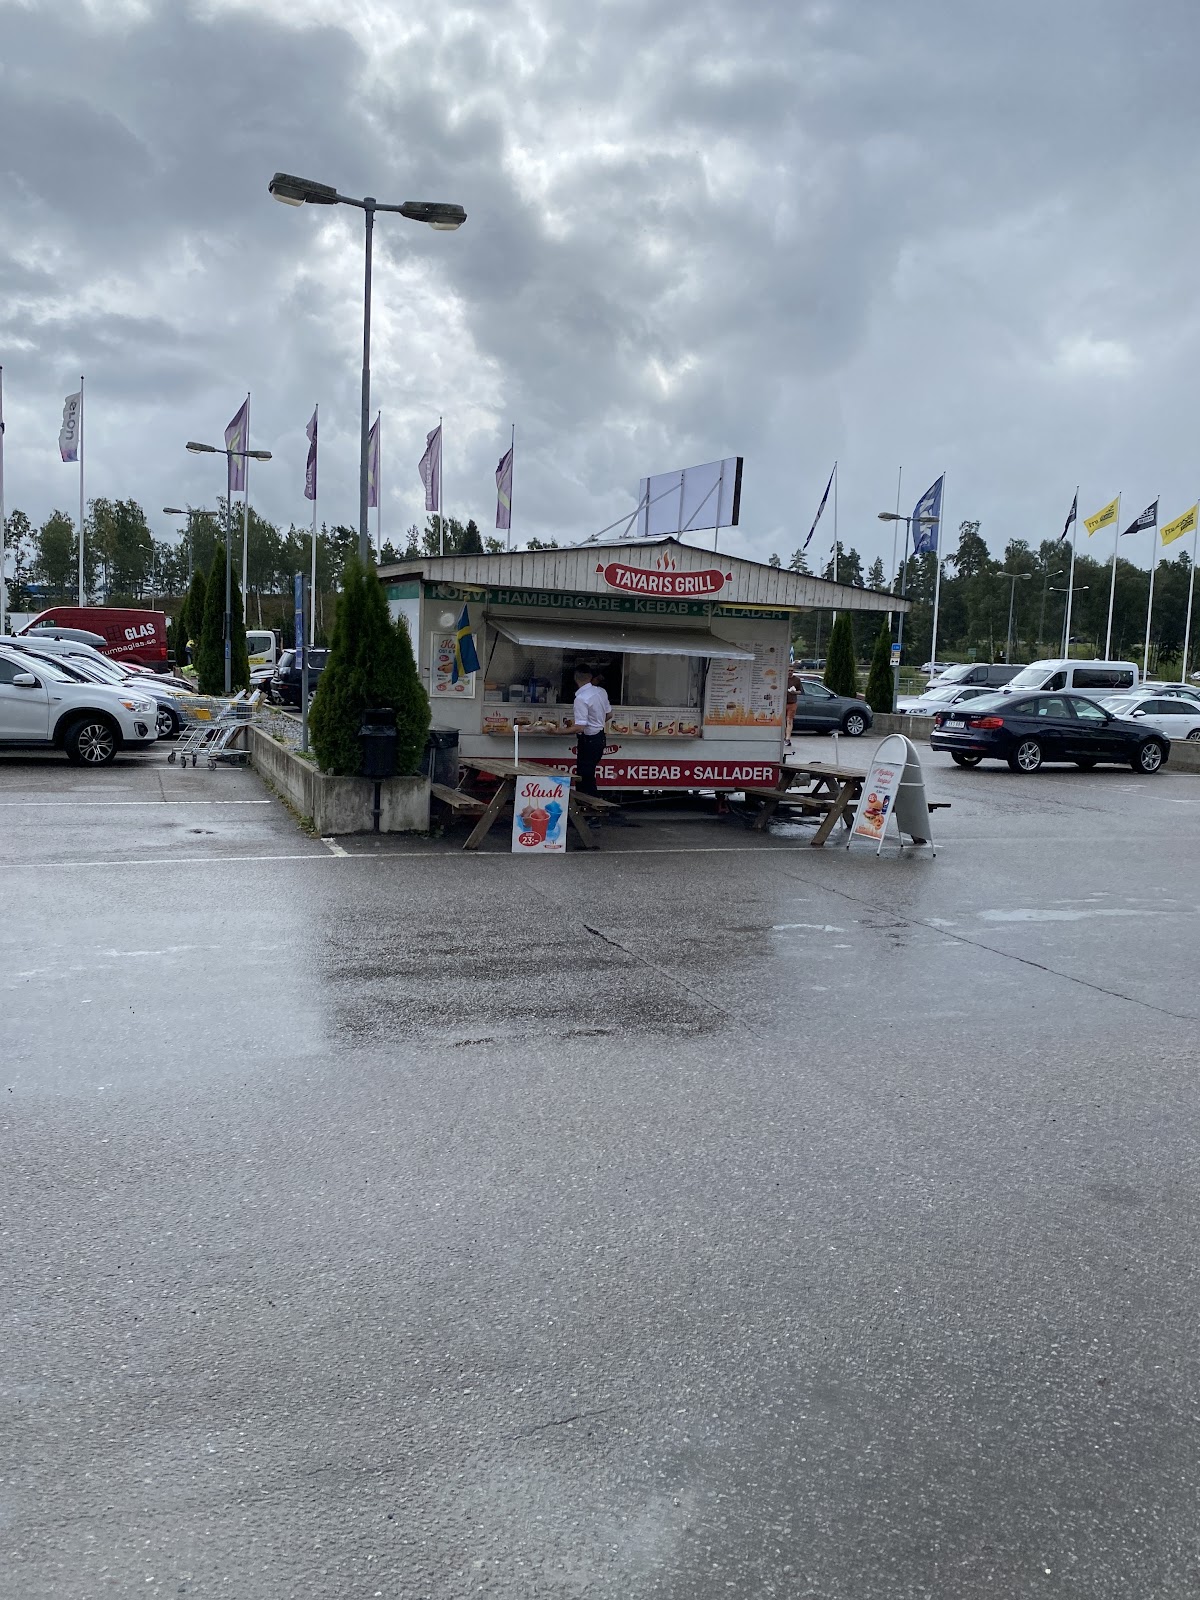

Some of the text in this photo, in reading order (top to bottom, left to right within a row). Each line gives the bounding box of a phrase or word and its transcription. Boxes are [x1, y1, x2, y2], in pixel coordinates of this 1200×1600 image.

[615, 568, 716, 593] TAYARIS GRILL
[498, 591, 621, 611] HAMBURGARE
[634, 599, 689, 614] KEBAB
[124, 623, 156, 640] GLAS
[626, 765, 681, 779] KEBAB
[693, 766, 773, 780] SALLADER
[520, 783, 563, 798] Slush
